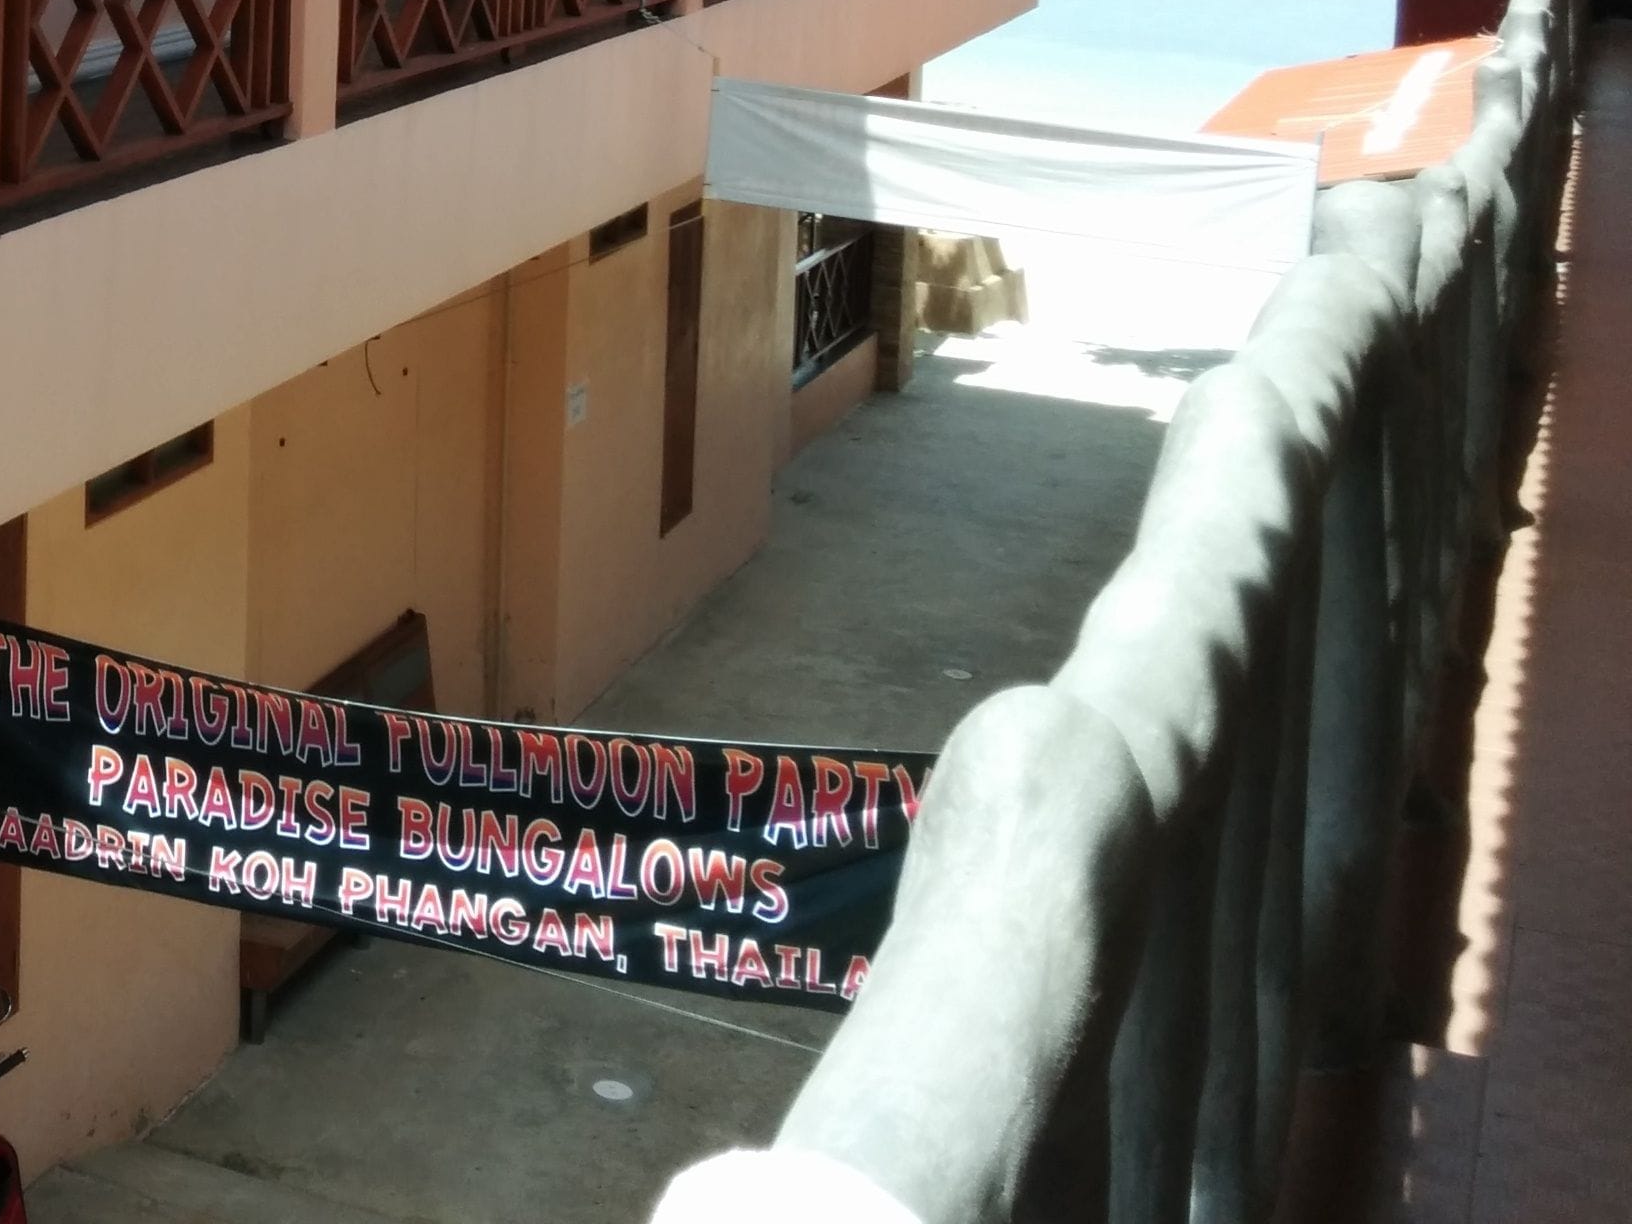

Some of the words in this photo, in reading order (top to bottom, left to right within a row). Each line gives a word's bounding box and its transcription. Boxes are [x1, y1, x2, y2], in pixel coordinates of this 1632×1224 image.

[94, 653, 361, 768] ORIGINAL
[374, 710, 697, 823] FULLMOON
[87, 744, 371, 851] PARADISE
[397, 795, 790, 924] BUNGALOWS
[207, 845, 318, 908] KOH
[337, 867, 629, 974] PHANGAN,
[654, 921, 872, 1002] THAILA
